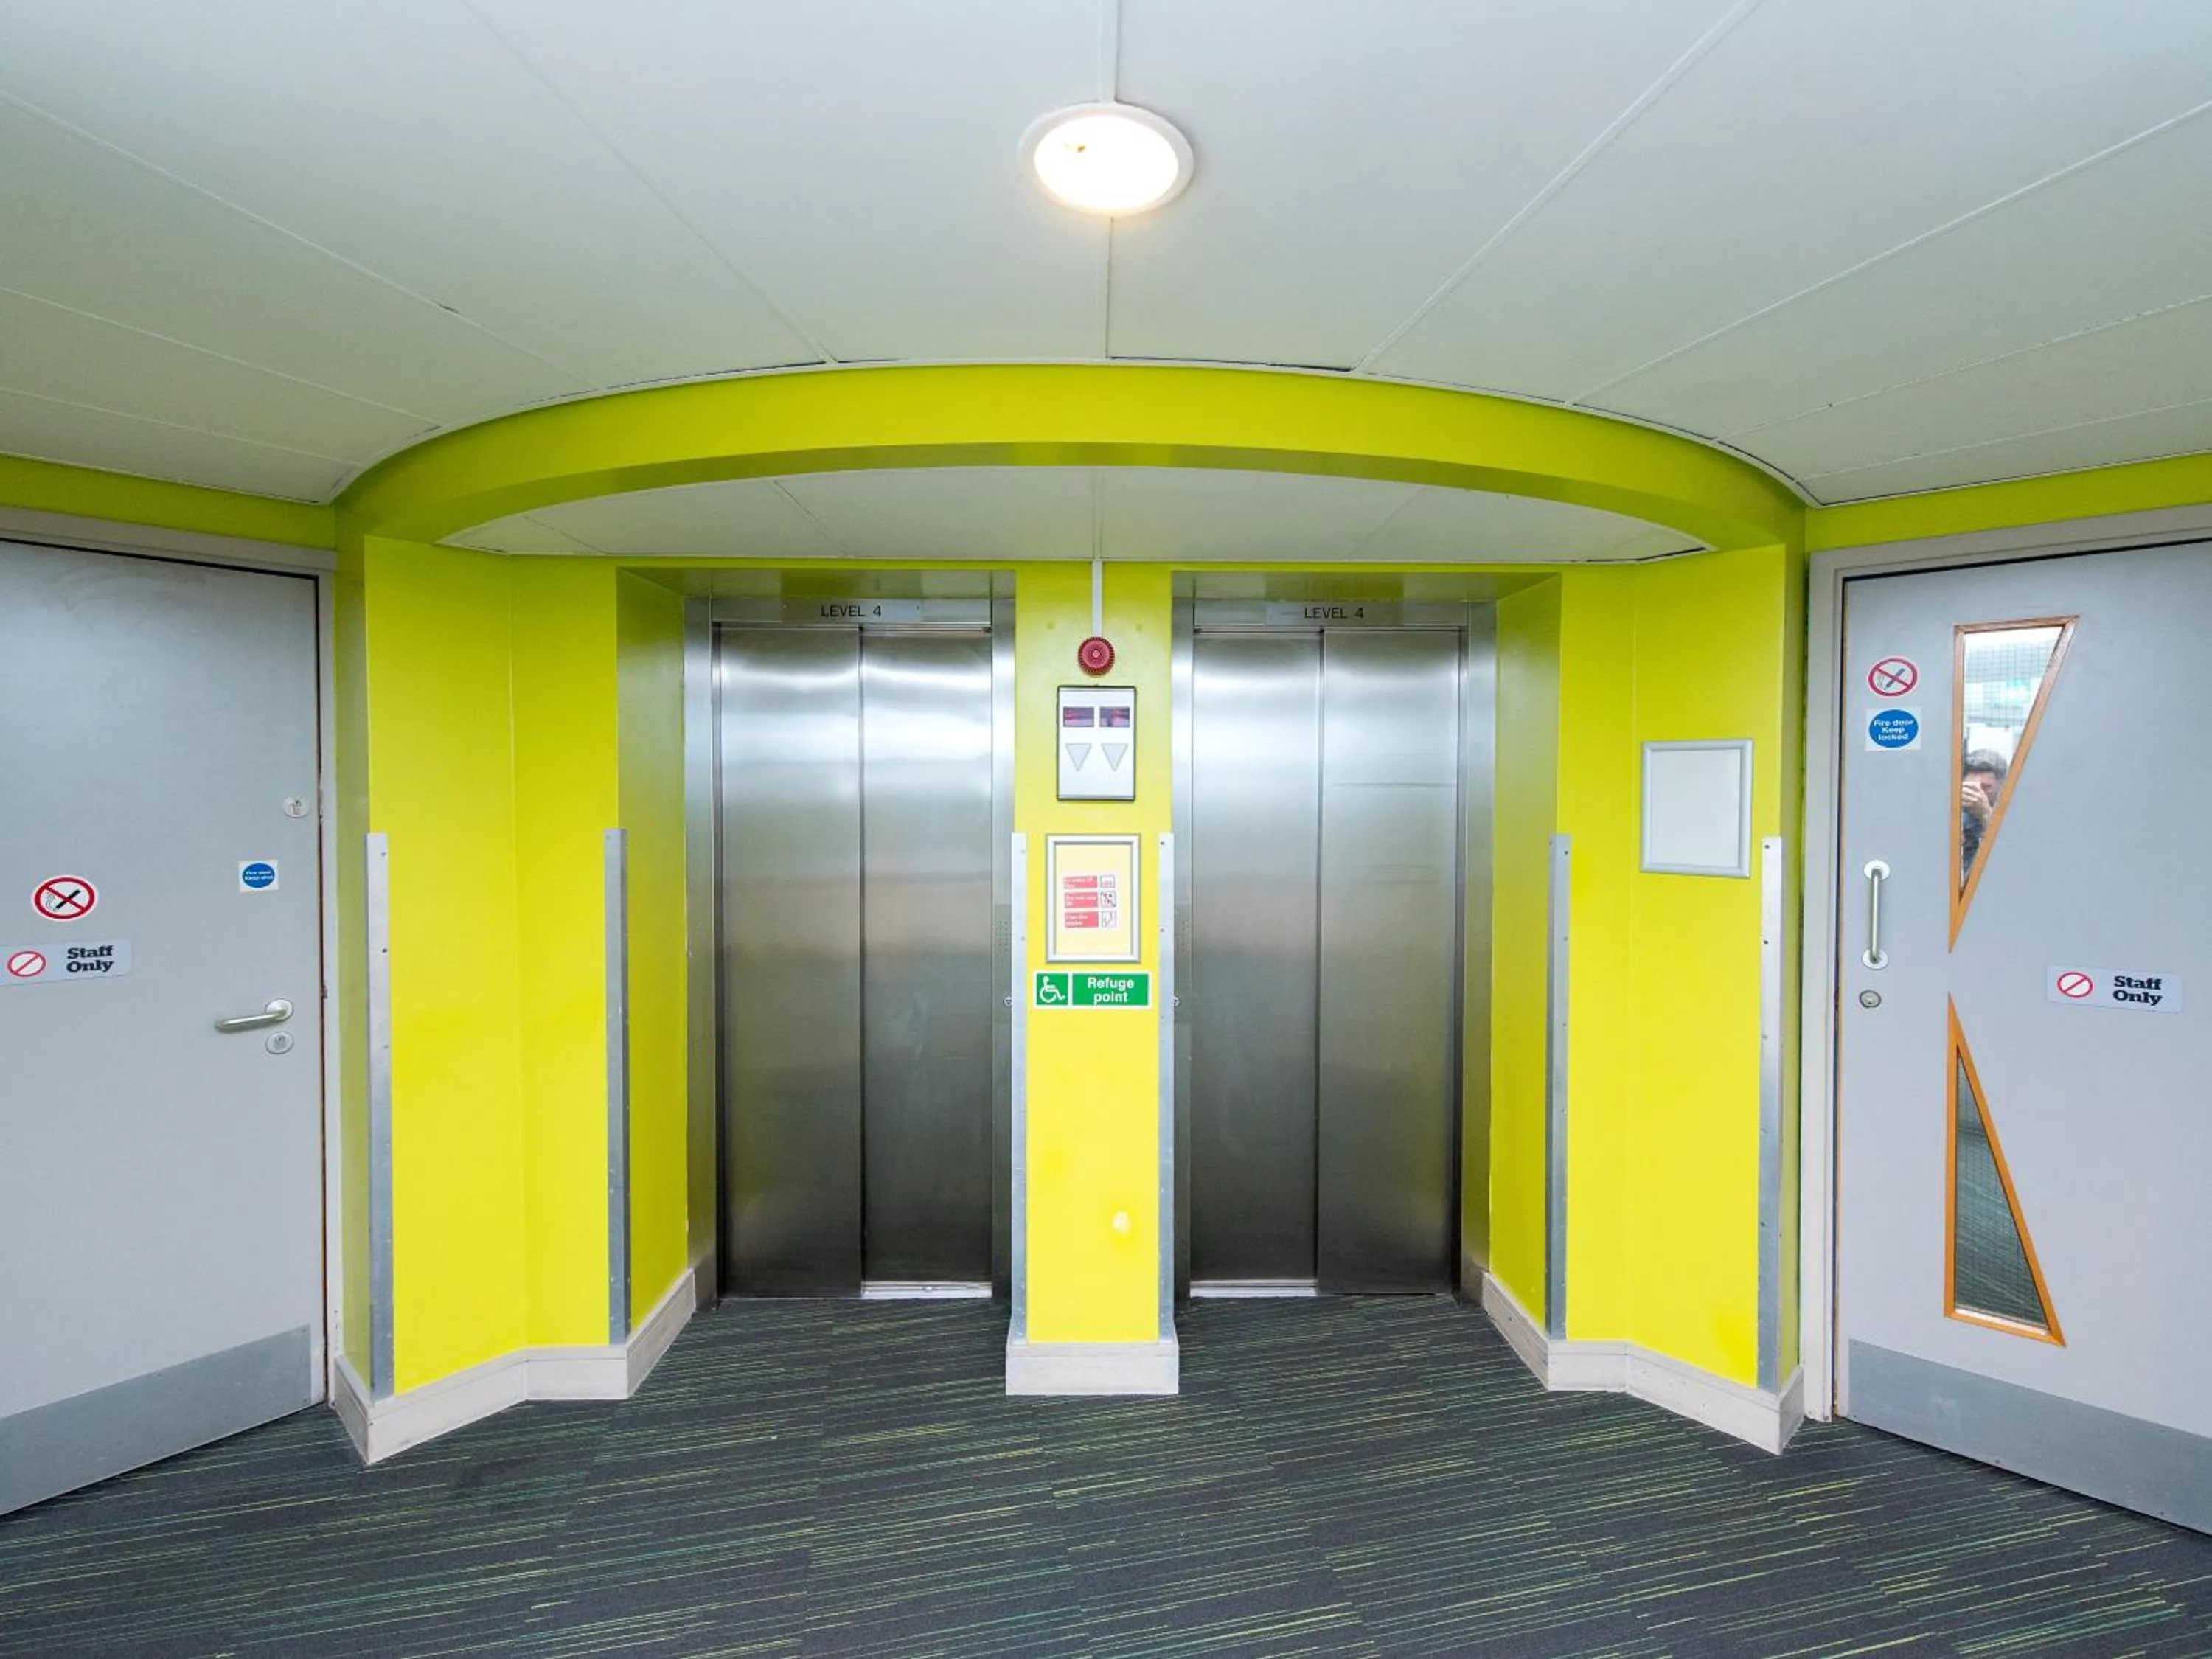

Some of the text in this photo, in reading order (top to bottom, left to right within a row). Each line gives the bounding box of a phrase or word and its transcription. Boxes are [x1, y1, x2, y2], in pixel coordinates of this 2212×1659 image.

[820, 605, 882, 617] LEVEL 4
[1304, 607, 1364, 619] LEVEL 4
[67, 945, 114, 959] Staff
[66, 960, 114, 973] Only
[1087, 977, 1135, 990] Refuge
[2114, 975, 2162, 990] Staff
[1093, 991, 1128, 1005] point
[2112, 990, 2163, 1006] Only
